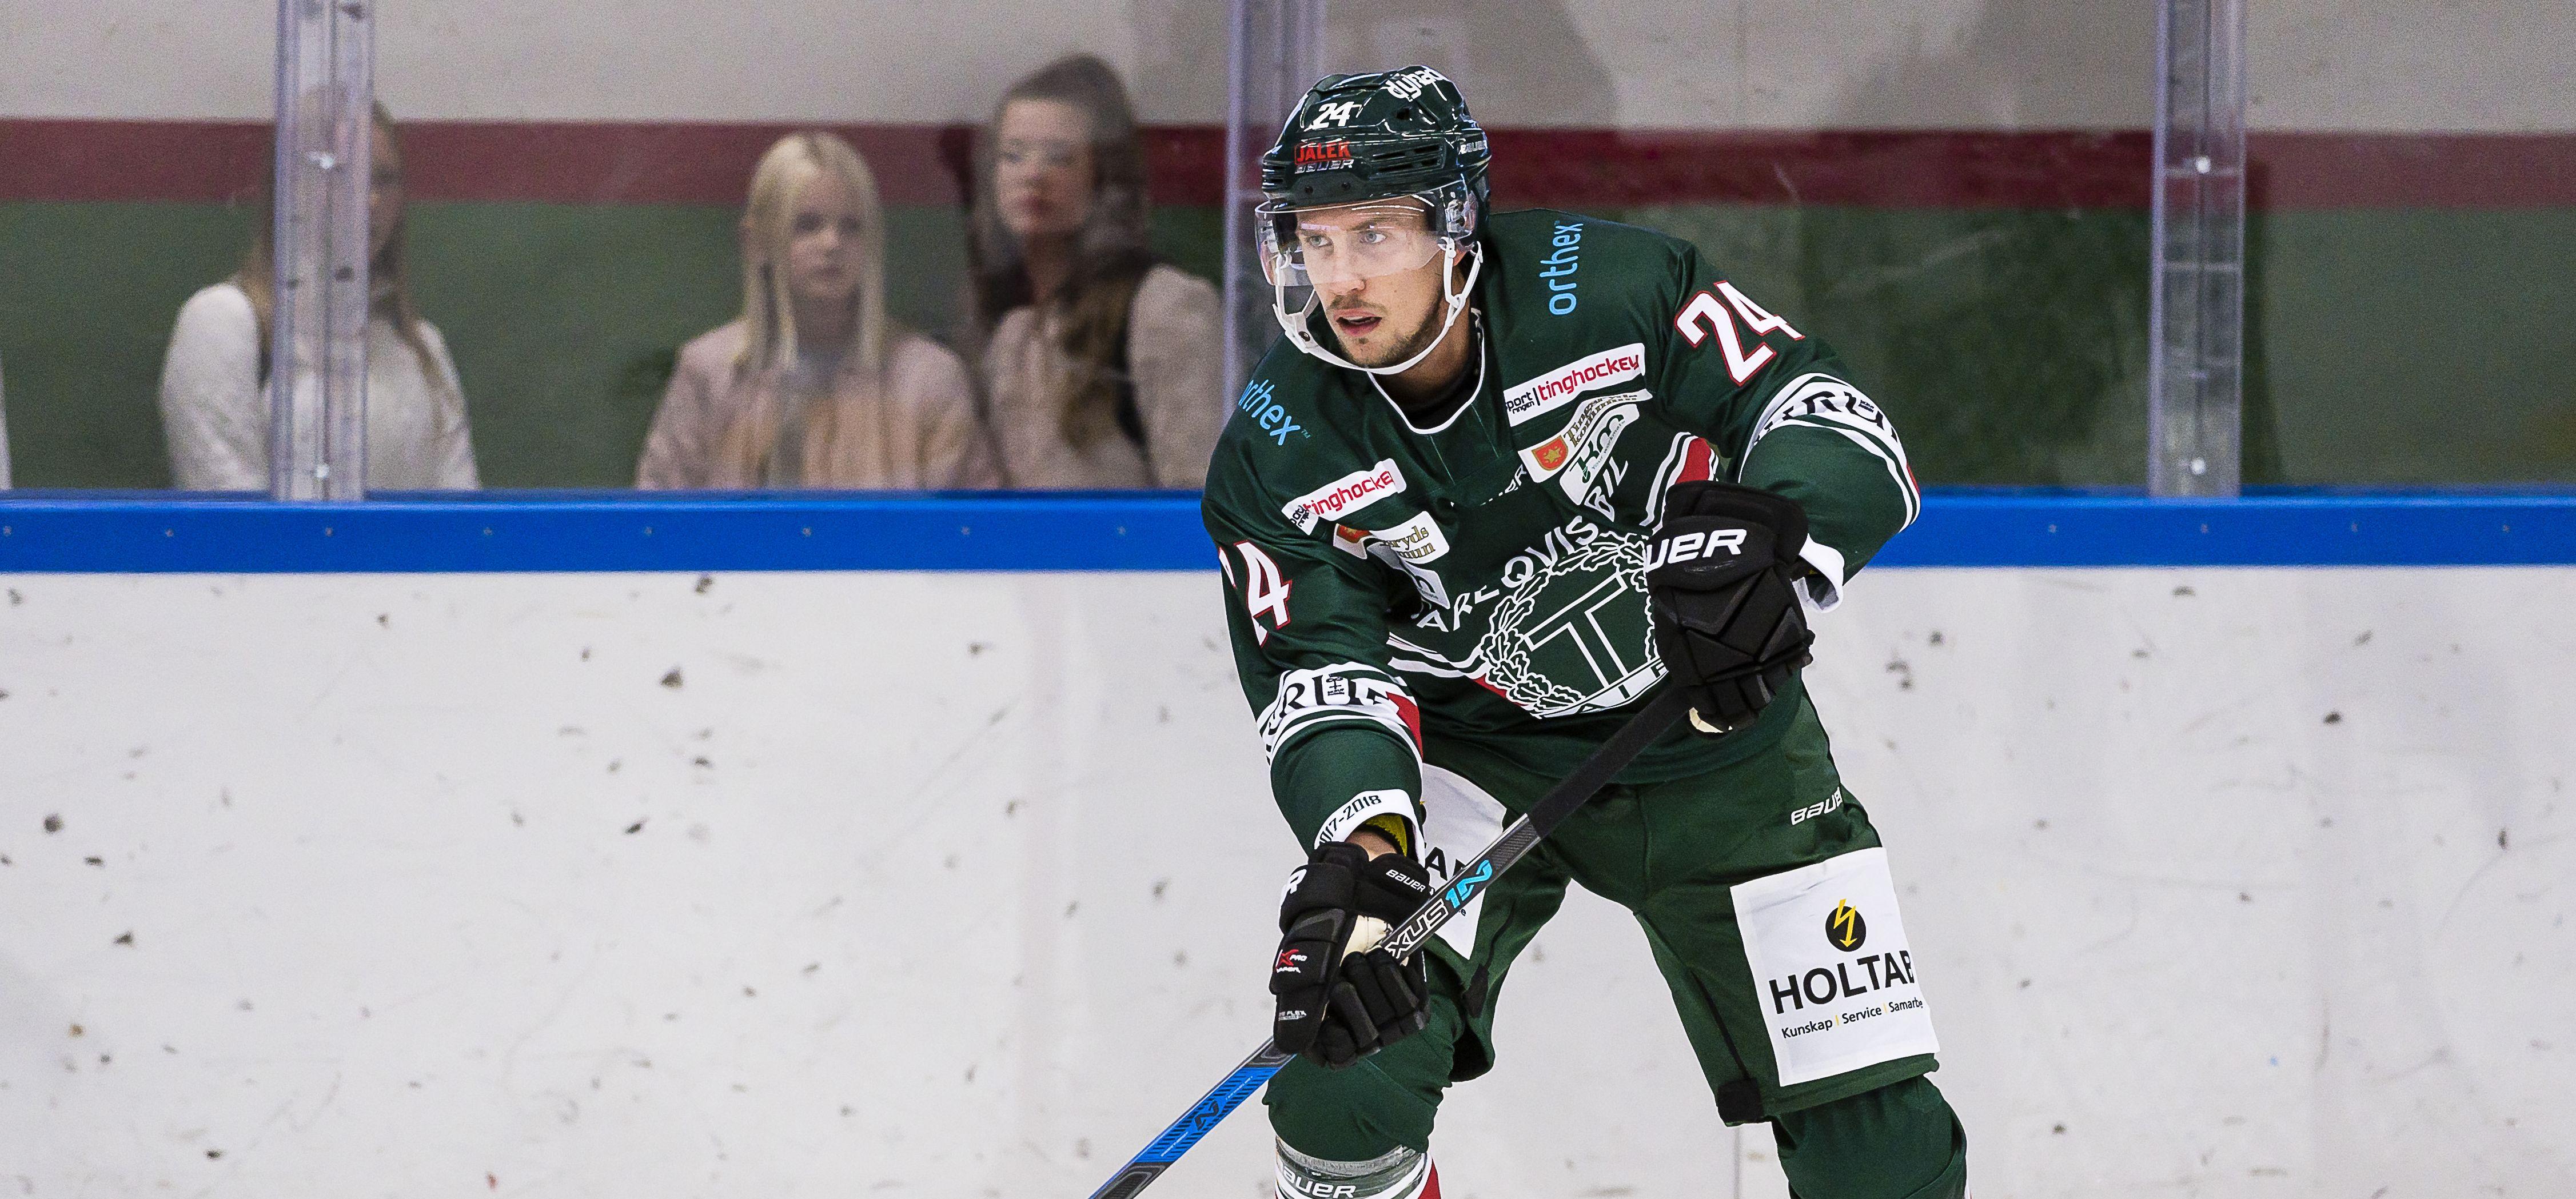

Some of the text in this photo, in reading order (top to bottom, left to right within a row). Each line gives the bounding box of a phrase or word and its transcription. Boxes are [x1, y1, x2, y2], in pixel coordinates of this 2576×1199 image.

[1312, 101, 1354, 130] 24
[1539, 223, 1584, 315] orthex
[1674, 280, 1805, 387] 24
[1302, 470, 1395, 515] tinghocke
[1413, 515, 1598, 632] ARLQVIS
[1584, 457, 1628, 522] BIL
[1645, 529, 1747, 573] UER
[1319, 795, 1382, 846] 017-2018
[1386, 869, 1426, 893] BAUER
[1385, 898, 1449, 959] XUS
[1781, 997, 1923, 1039] Kunskap Service Samarbe
